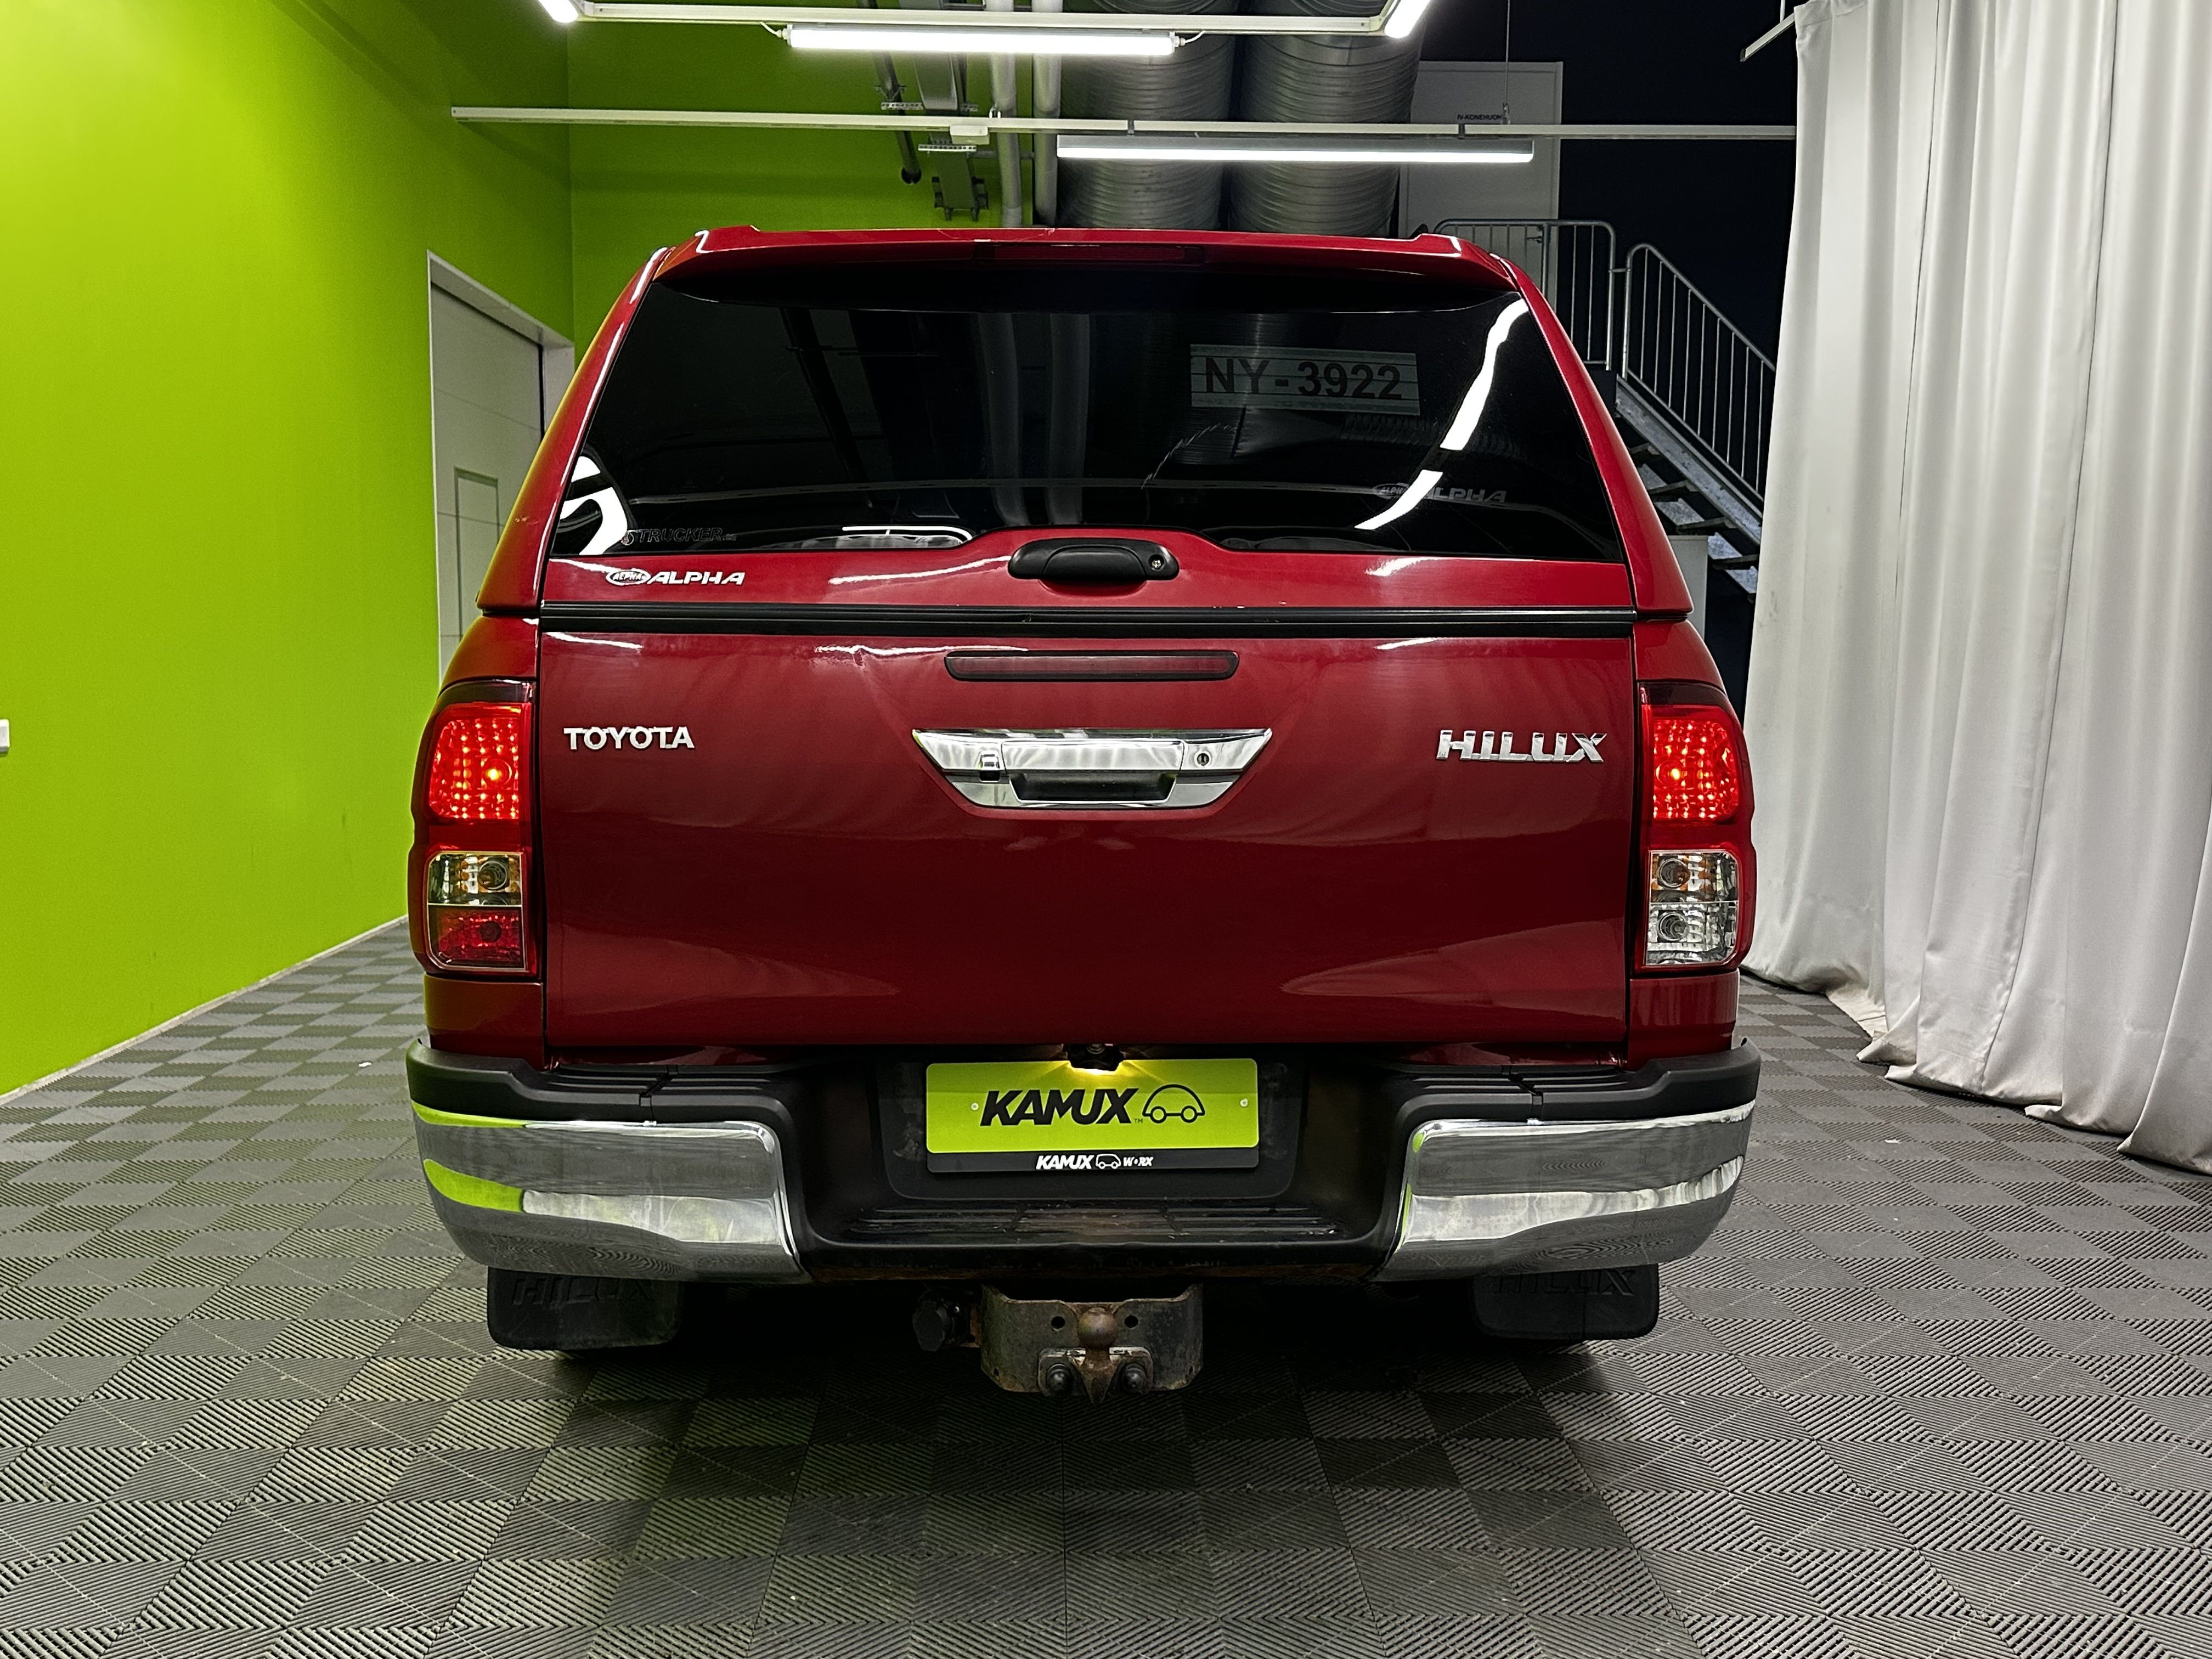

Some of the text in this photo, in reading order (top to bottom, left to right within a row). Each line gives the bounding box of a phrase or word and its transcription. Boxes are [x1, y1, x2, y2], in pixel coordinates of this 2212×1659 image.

[1206, 357, 1402, 400] NY-3922
[1424, 487, 1507, 503] LPHA
[612, 571, 746, 585] ALPHA ALPHA
[563, 726, 695, 751] TOYOTA
[1436, 729, 1607, 763] HILUX
[980, 1087, 1139, 1127] KAMUX
[1035, 1154, 1094, 1170] KAMUX
